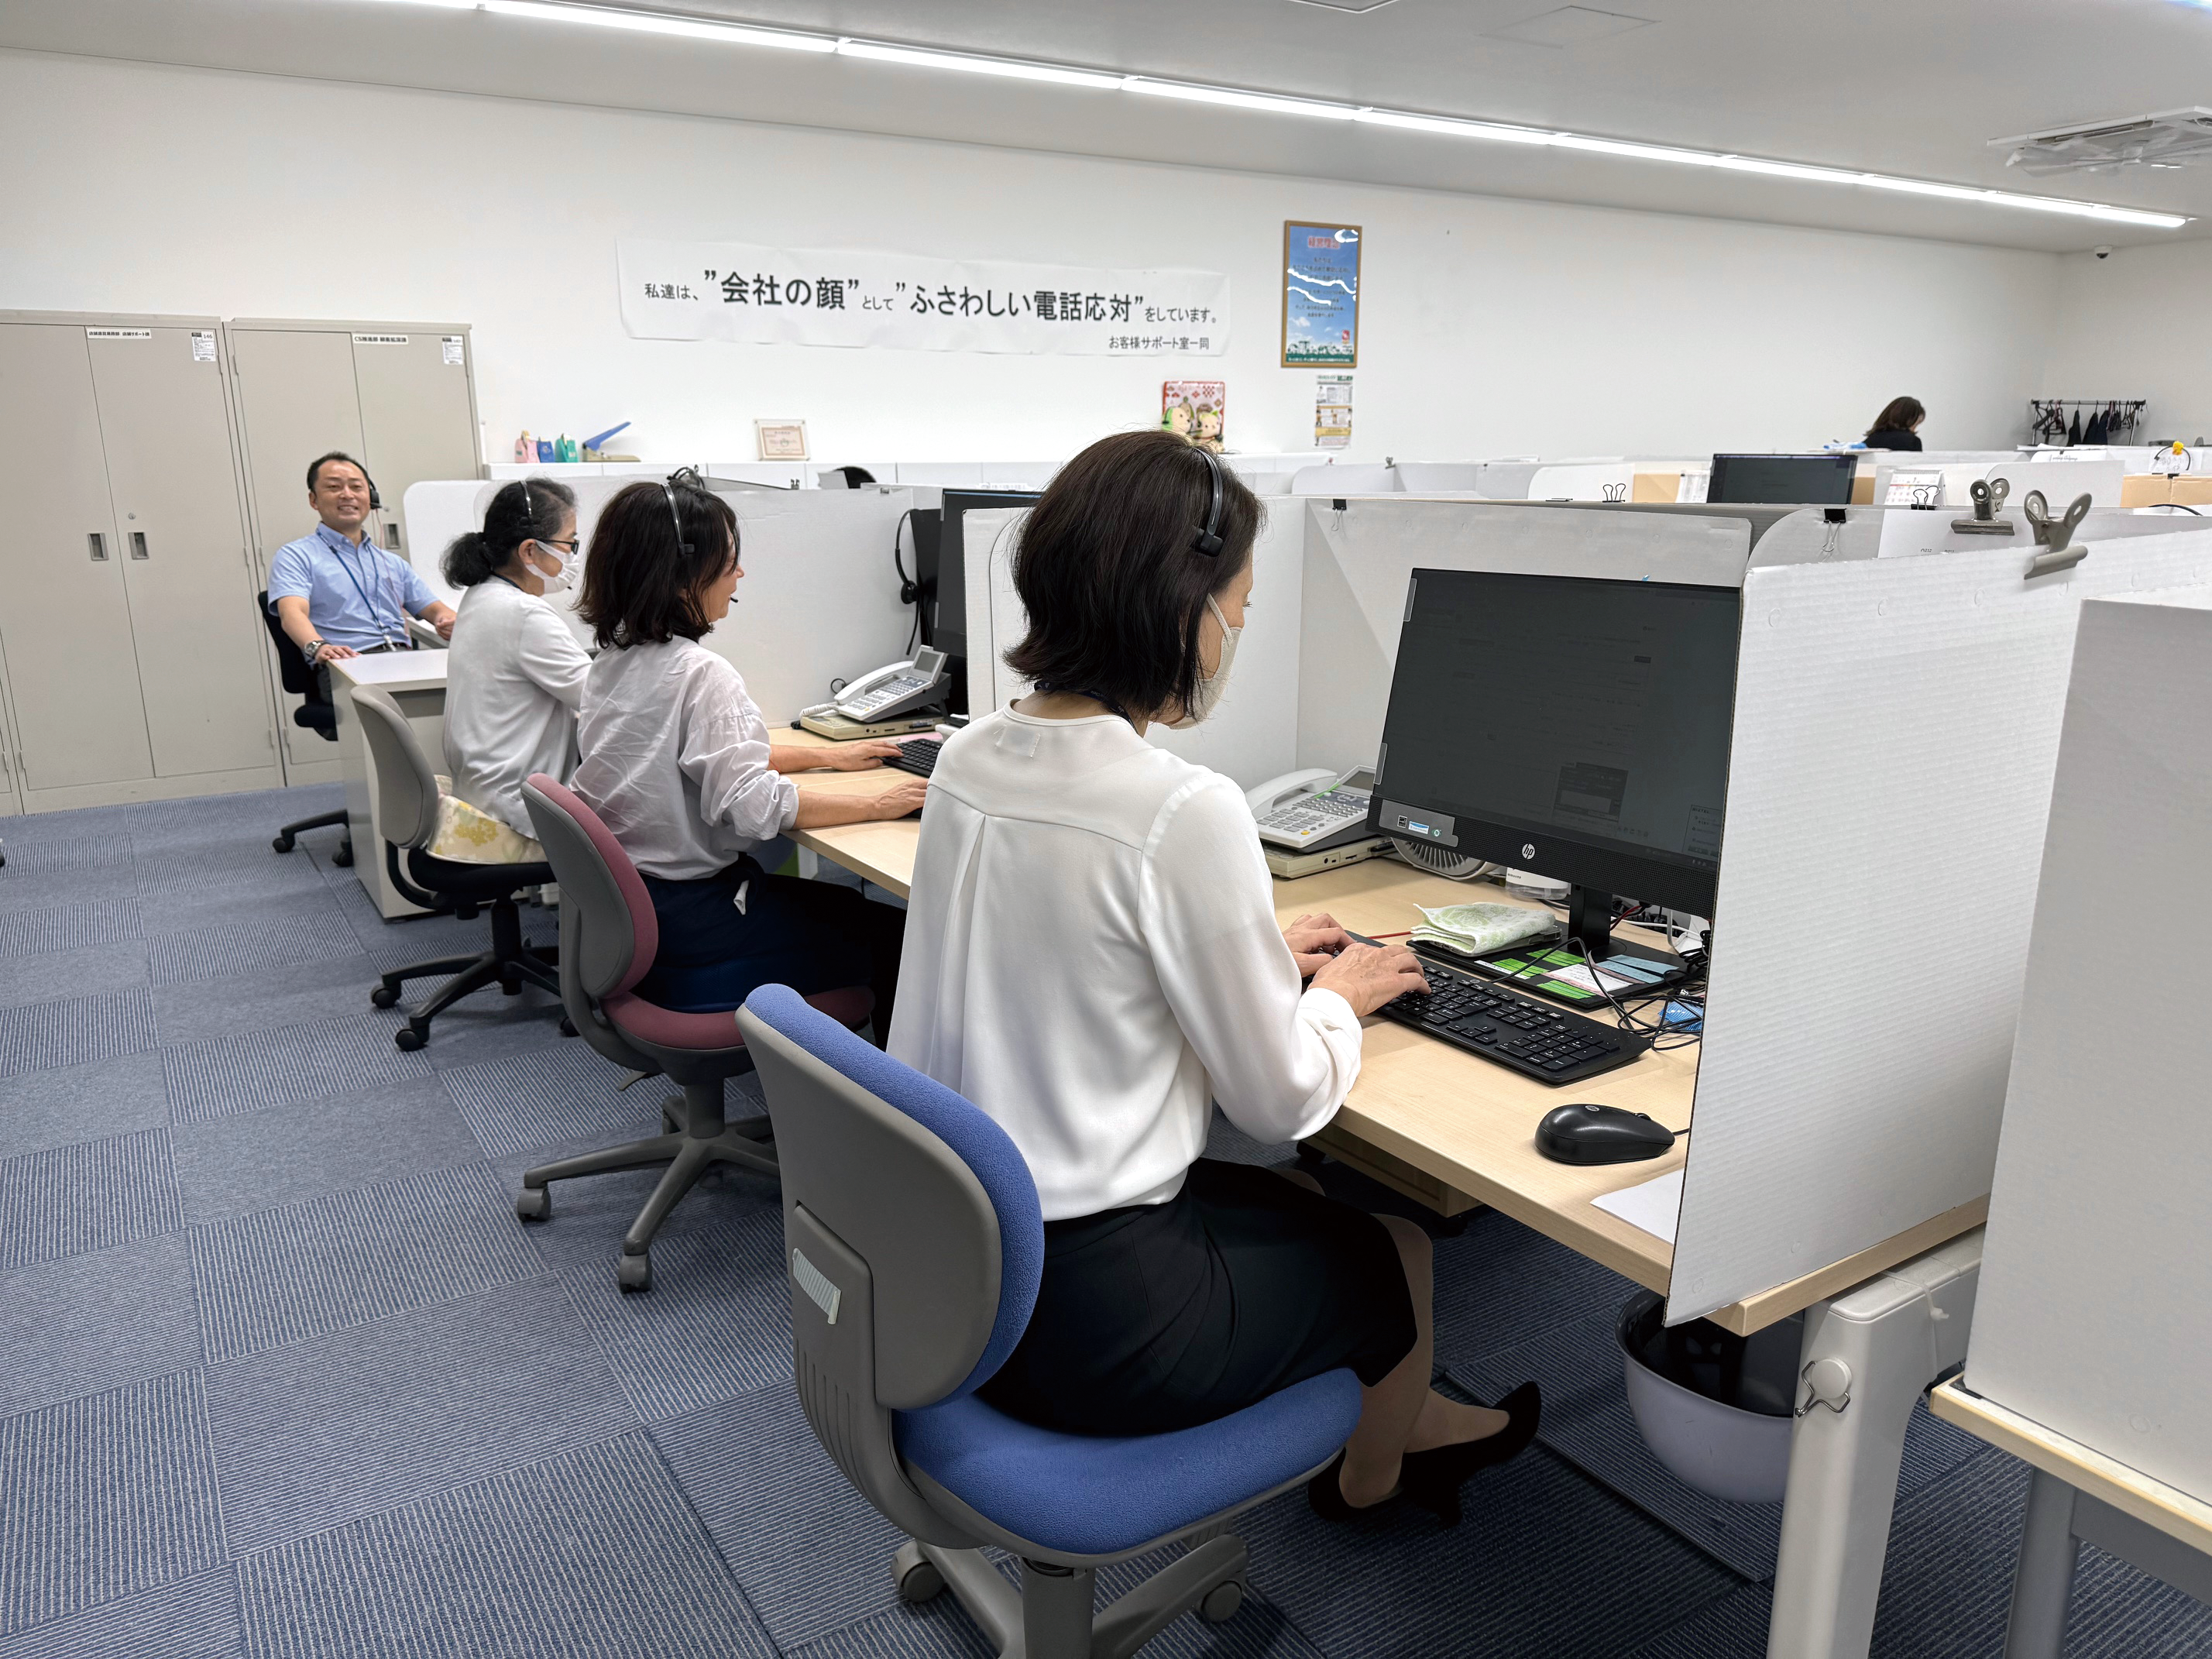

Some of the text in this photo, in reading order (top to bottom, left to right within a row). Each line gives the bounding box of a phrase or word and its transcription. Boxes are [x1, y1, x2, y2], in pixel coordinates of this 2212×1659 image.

[1108, 335, 1210, 350] お客様サポート室一同
[1522, 843, 1535, 860] hp
